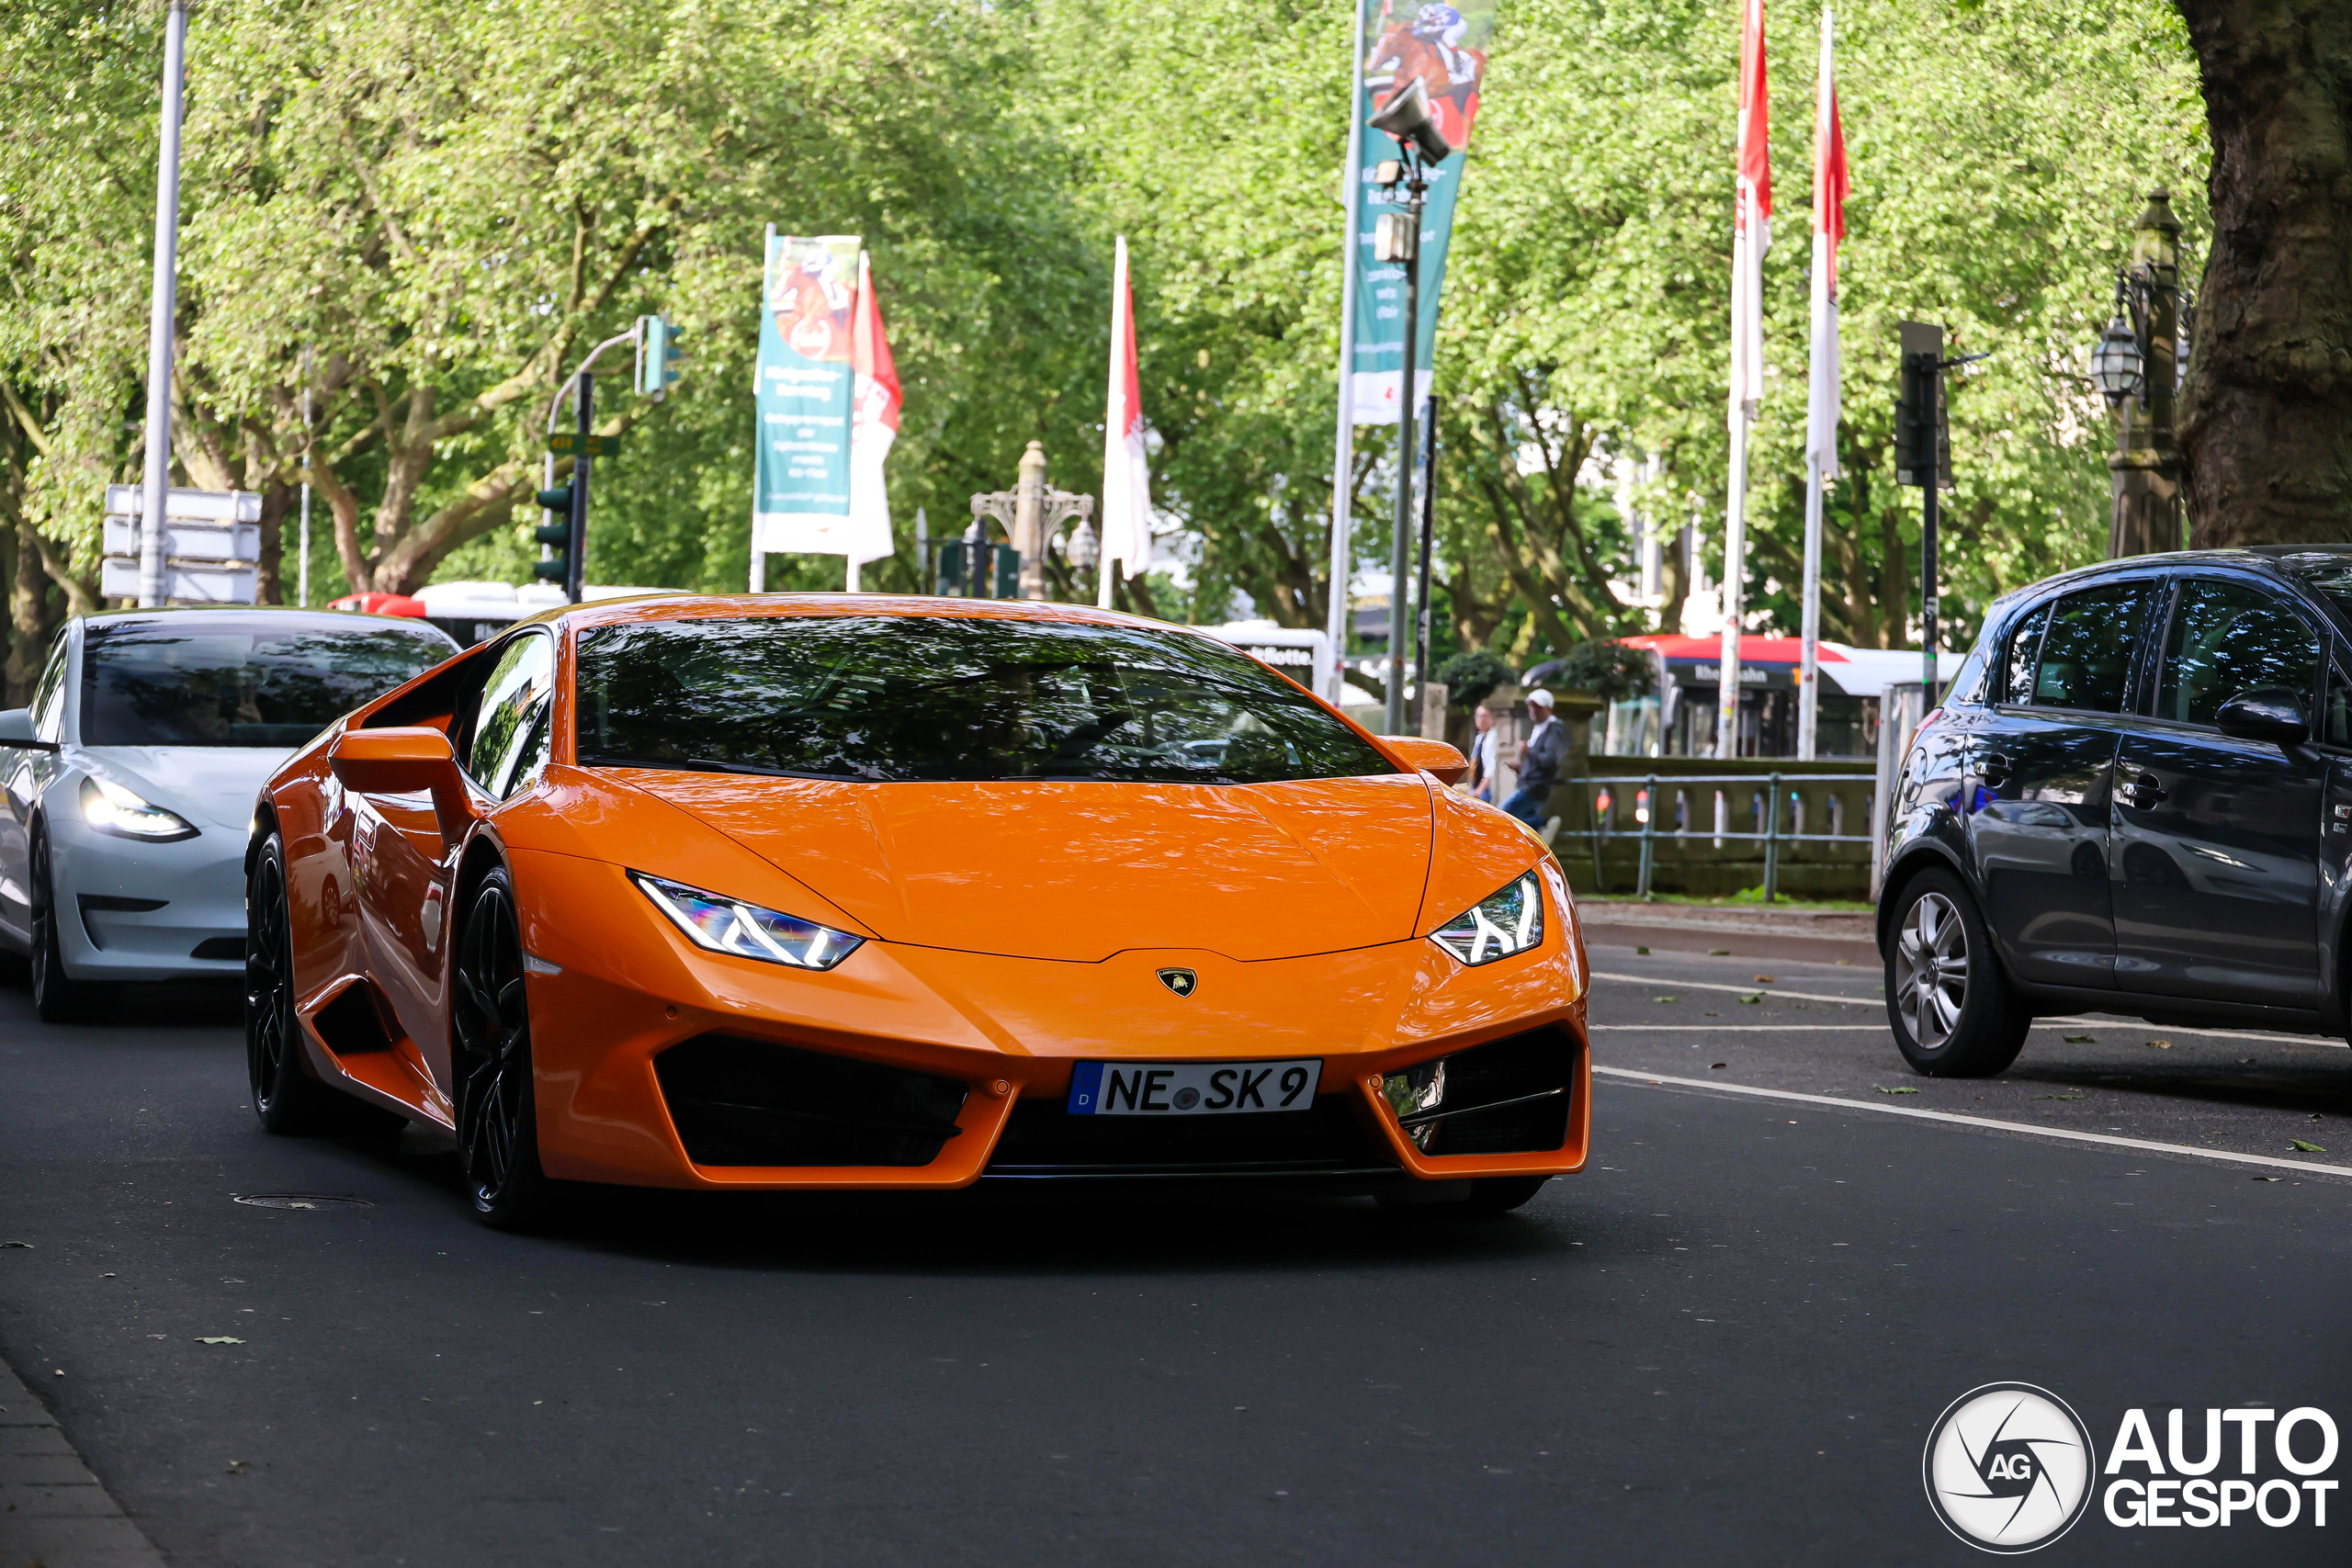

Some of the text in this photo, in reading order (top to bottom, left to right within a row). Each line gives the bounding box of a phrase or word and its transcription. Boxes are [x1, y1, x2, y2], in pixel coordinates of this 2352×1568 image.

[1078, 1094, 1090, 1106] D
[1105, 1066, 1308, 1111] NE SK 9
